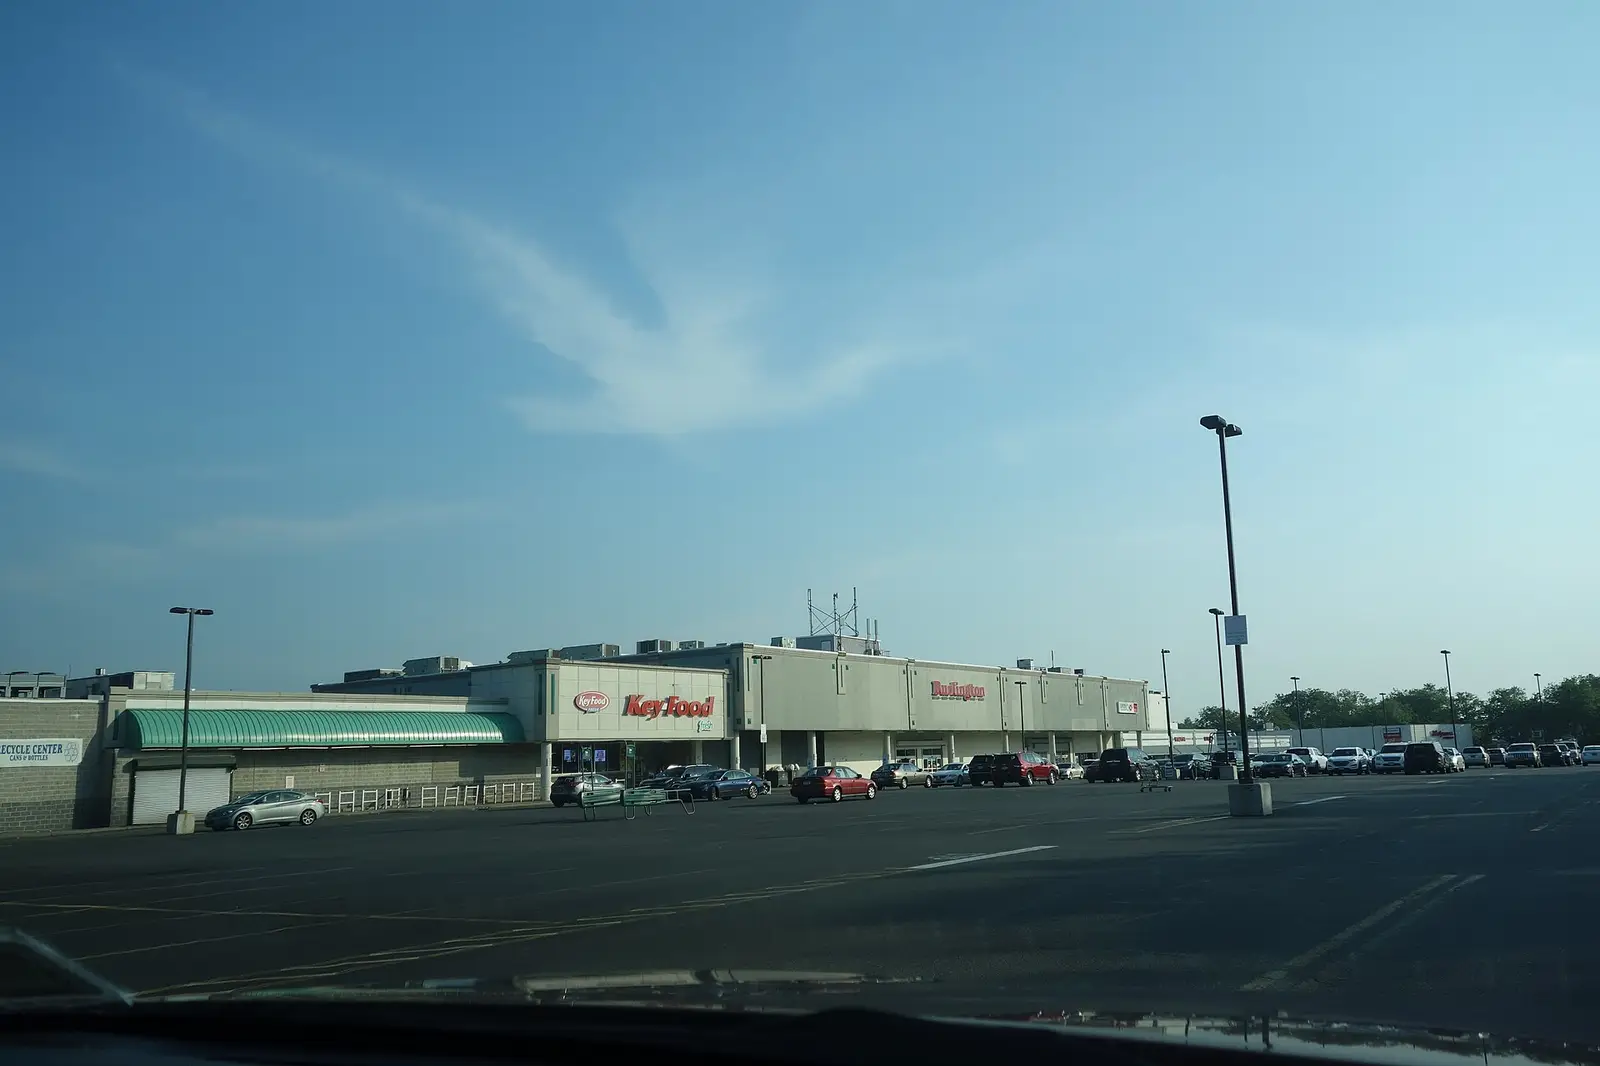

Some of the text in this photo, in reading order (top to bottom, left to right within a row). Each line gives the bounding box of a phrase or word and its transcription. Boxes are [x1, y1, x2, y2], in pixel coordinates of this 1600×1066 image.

[931, 681, 985, 701] Burlington
[579, 695, 606, 707] Key Food
[625, 695, 715, 720] Key Food
[32, 744, 63, 754] CENTER
